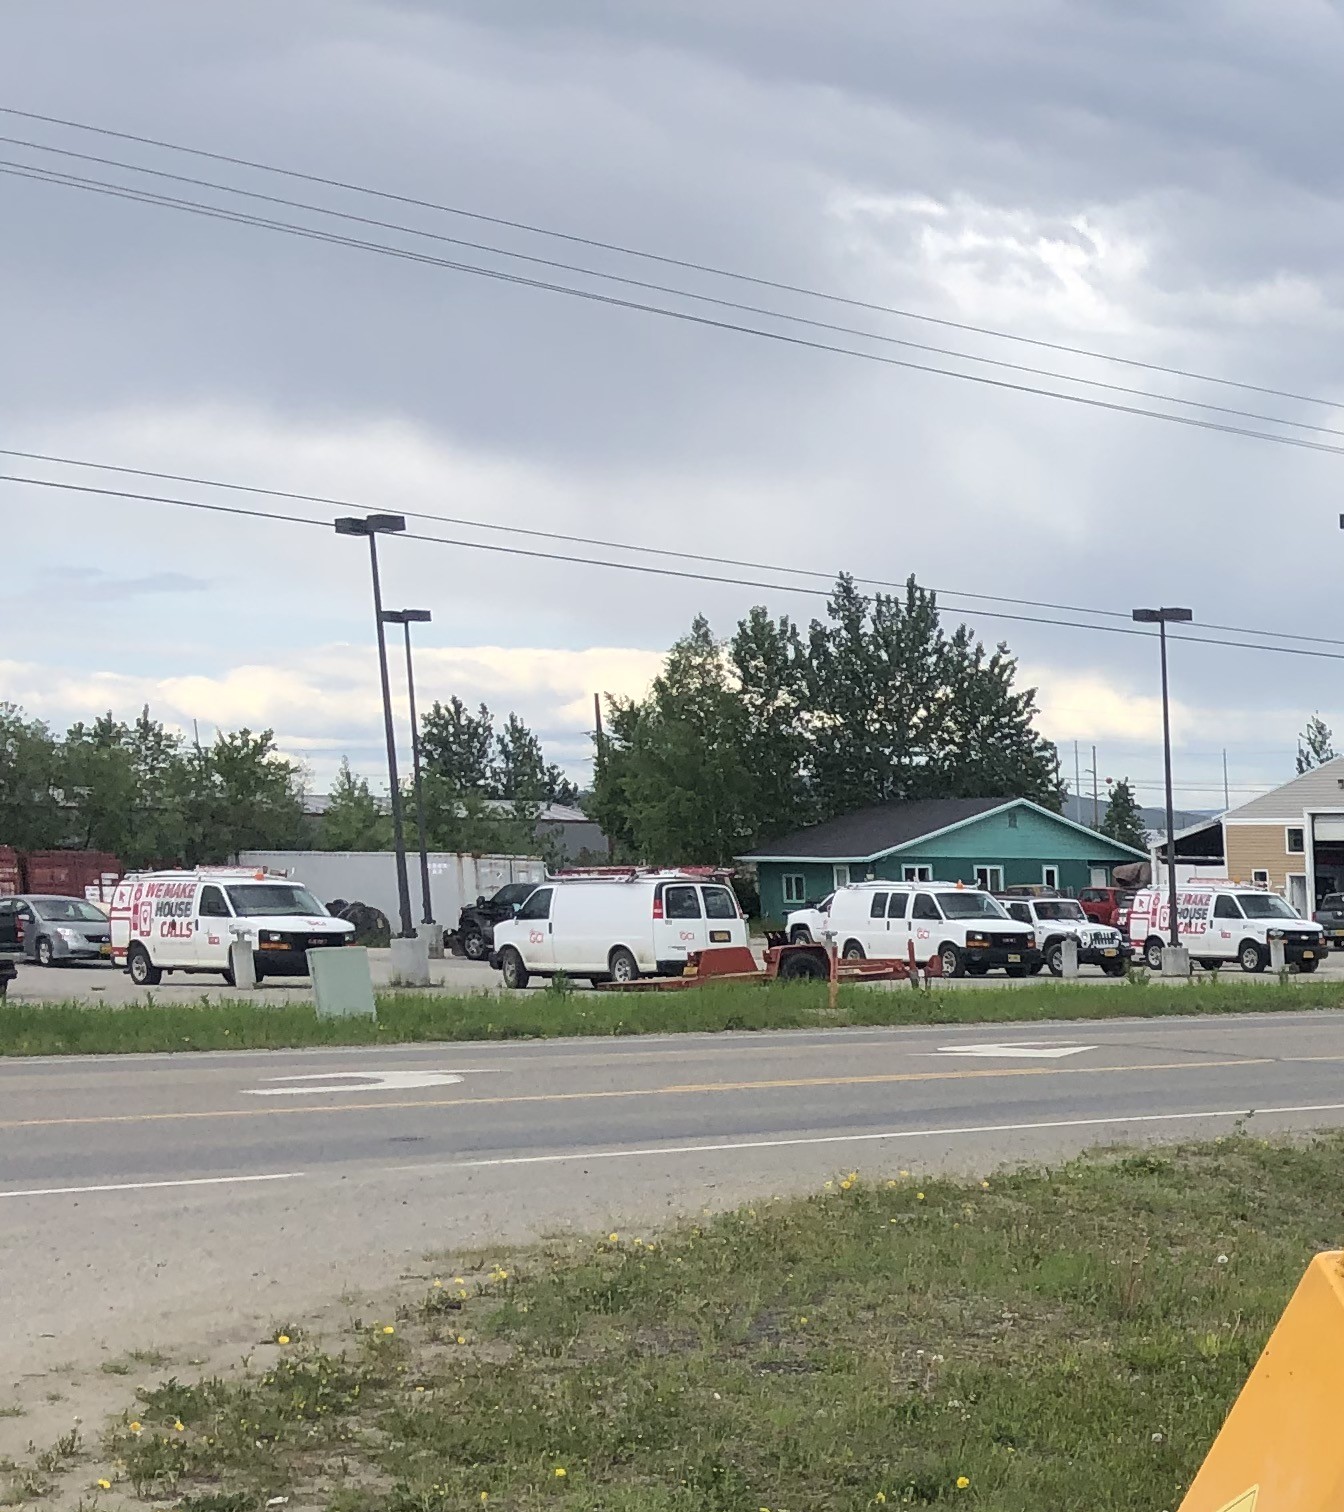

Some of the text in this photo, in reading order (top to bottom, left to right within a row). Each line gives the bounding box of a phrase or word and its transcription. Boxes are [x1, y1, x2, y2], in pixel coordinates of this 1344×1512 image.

[146, 883, 197, 899] WE MAKE
[1182, 894, 1212, 906] MAKE
[155, 901, 192, 917] HOUSE
[1177, 907, 1208, 920] HOUSE
[160, 921, 193, 938] CALLS
[1177, 921, 1207, 934] CALLS
